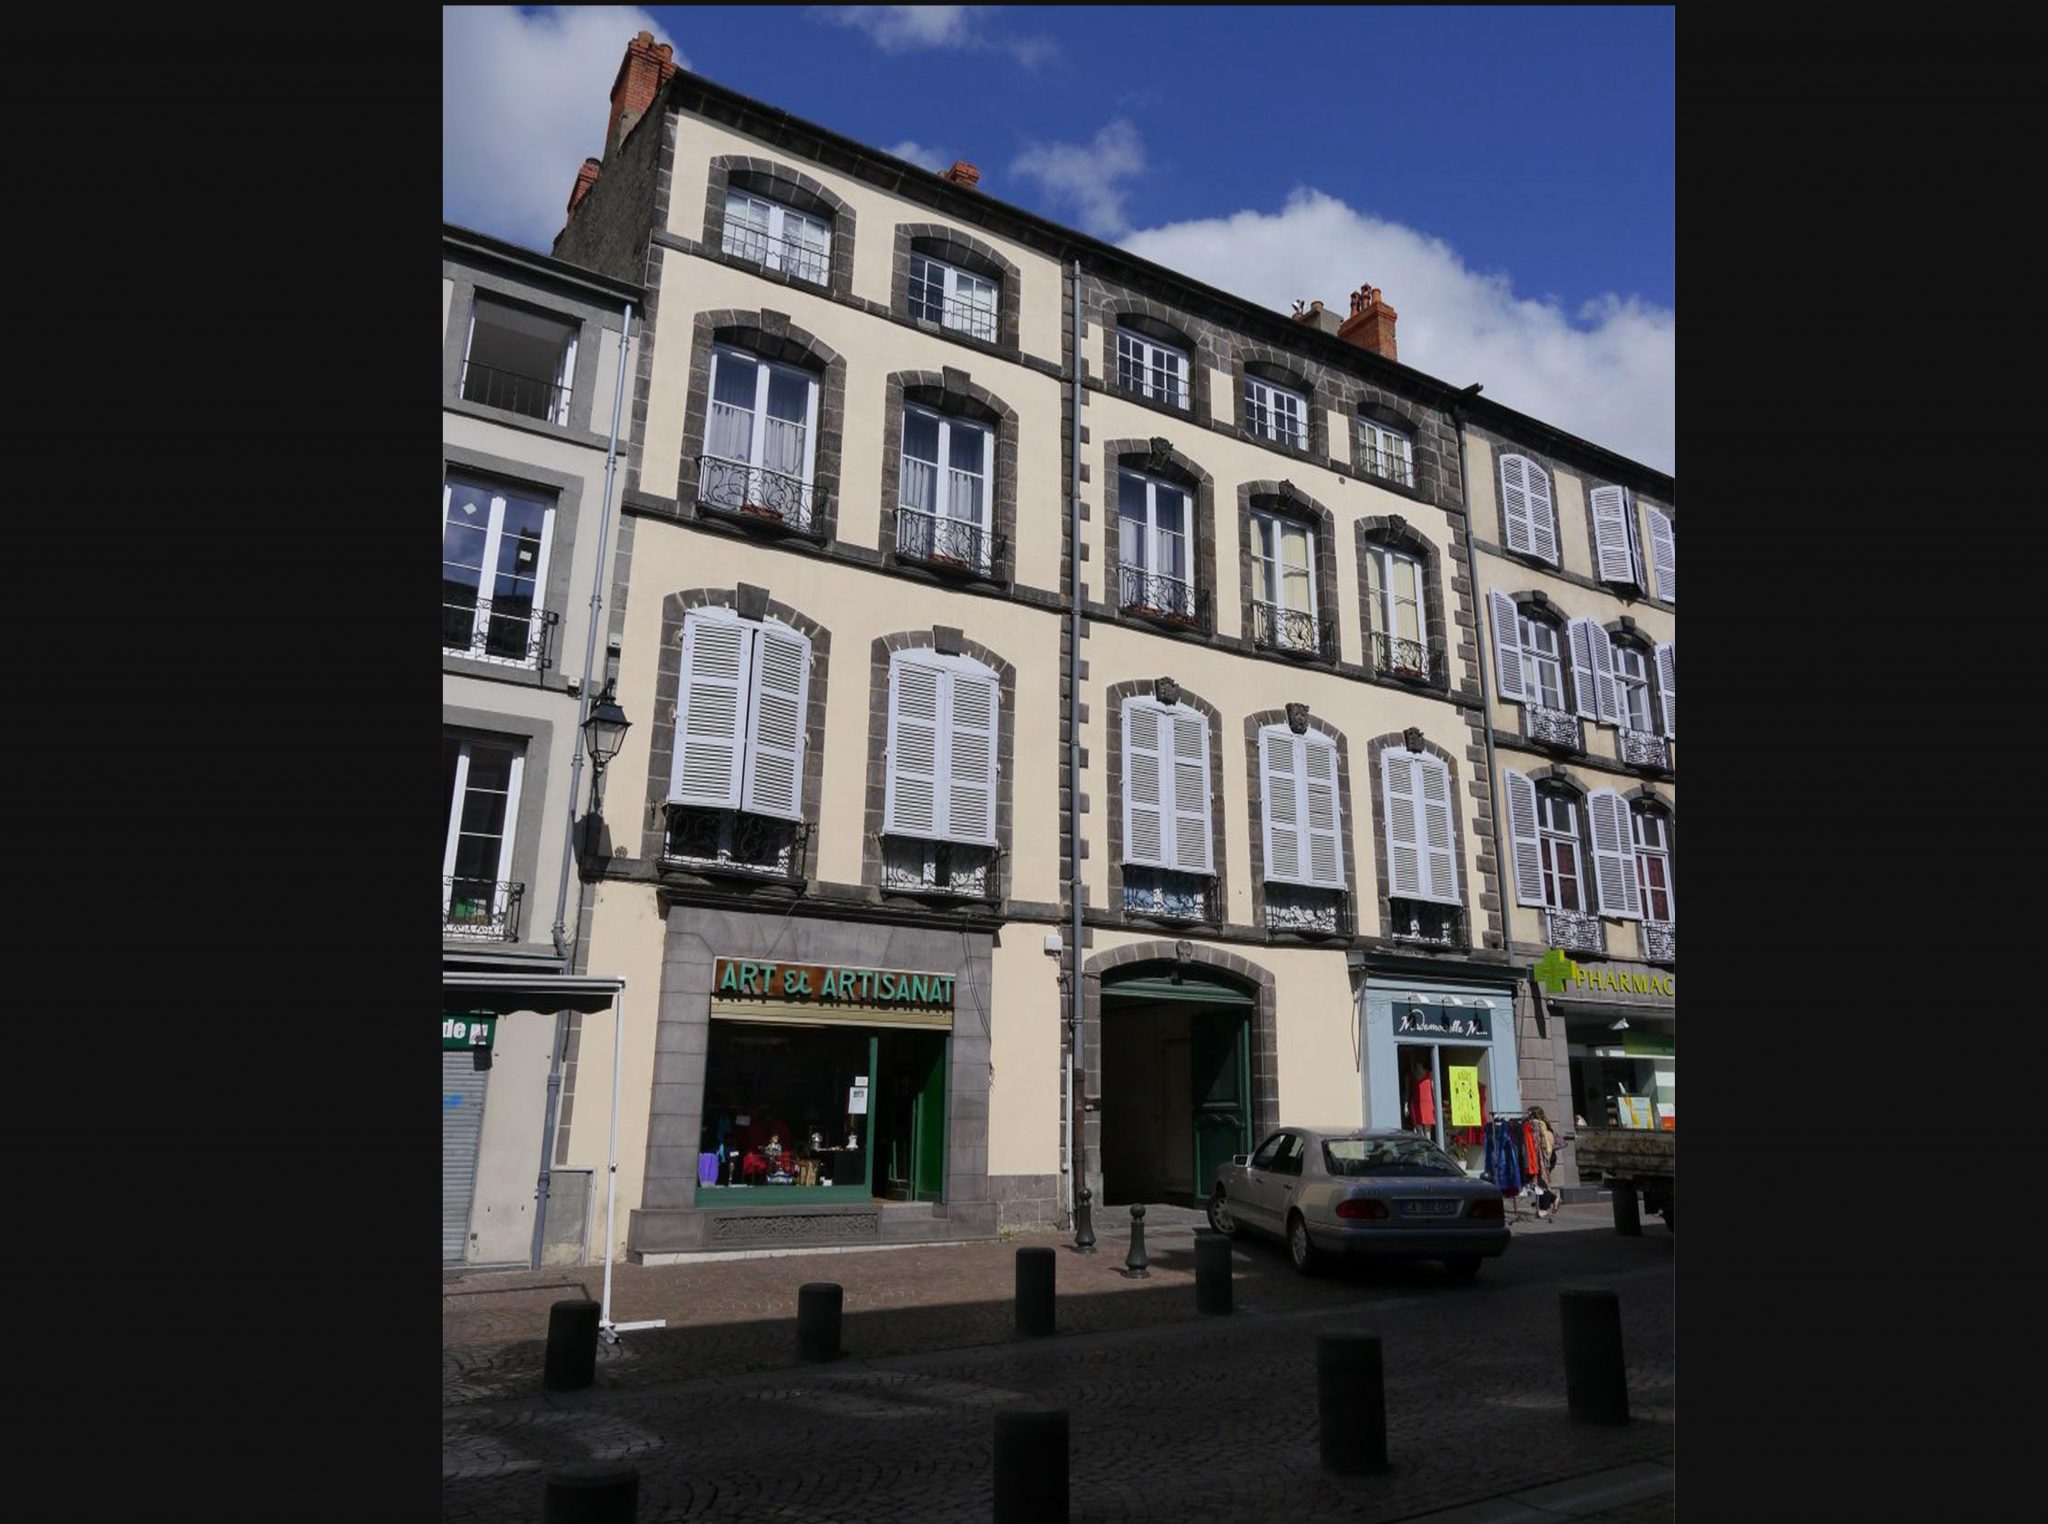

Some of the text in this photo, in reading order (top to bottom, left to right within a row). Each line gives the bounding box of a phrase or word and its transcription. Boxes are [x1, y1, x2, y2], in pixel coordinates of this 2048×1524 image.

[721, 961, 777, 993] ART
[821, 969, 955, 1003] ARTISANAT
[1576, 967, 1675, 997] PHARMAC
